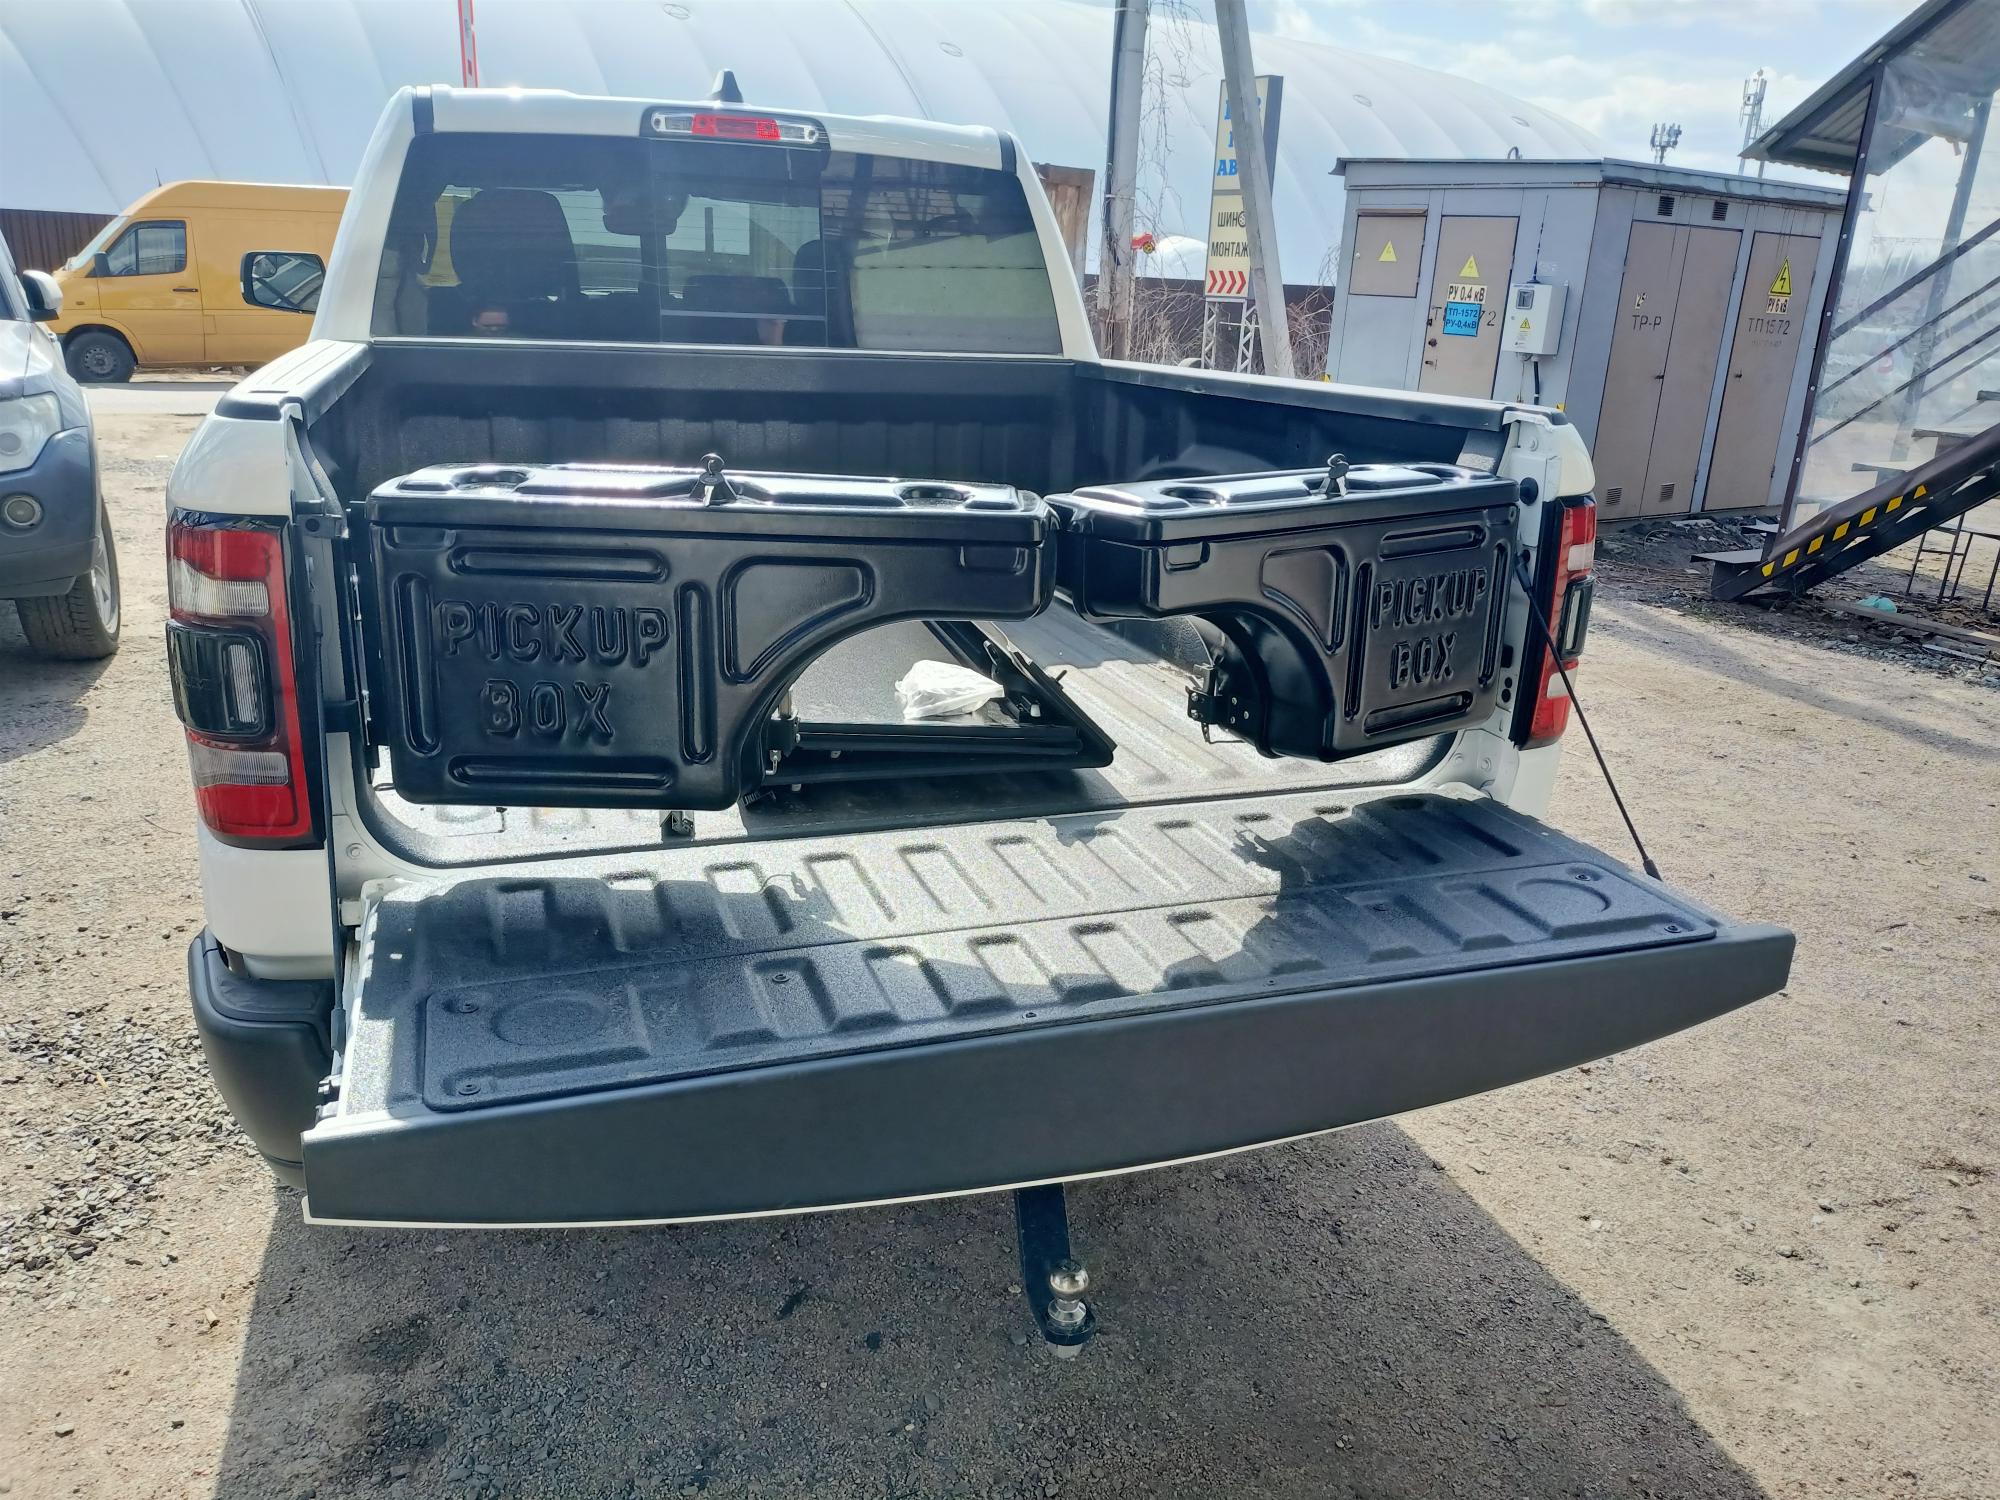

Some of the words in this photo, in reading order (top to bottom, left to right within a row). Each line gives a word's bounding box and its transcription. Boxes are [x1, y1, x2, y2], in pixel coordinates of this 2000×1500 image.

[1216, 159, 1238, 176] АВ
[1210, 241, 1249, 257] МОНТАЖ
[1448, 285, 1459, 300] РУ
[1474, 287, 1485, 302] кВ
[1448, 307, 1478, 318] ТП-1572
[1767, 297, 1776, 312] РУ
[1775, 298, 1781, 312] 6
[1445, 318, 1477, 329] РУ-0,4кВ
[1371, 567, 1487, 630] PICKUP
[433, 599, 671, 668] PICKUP
[1389, 631, 1458, 690] BOX
[480, 678, 616, 745] BOX
